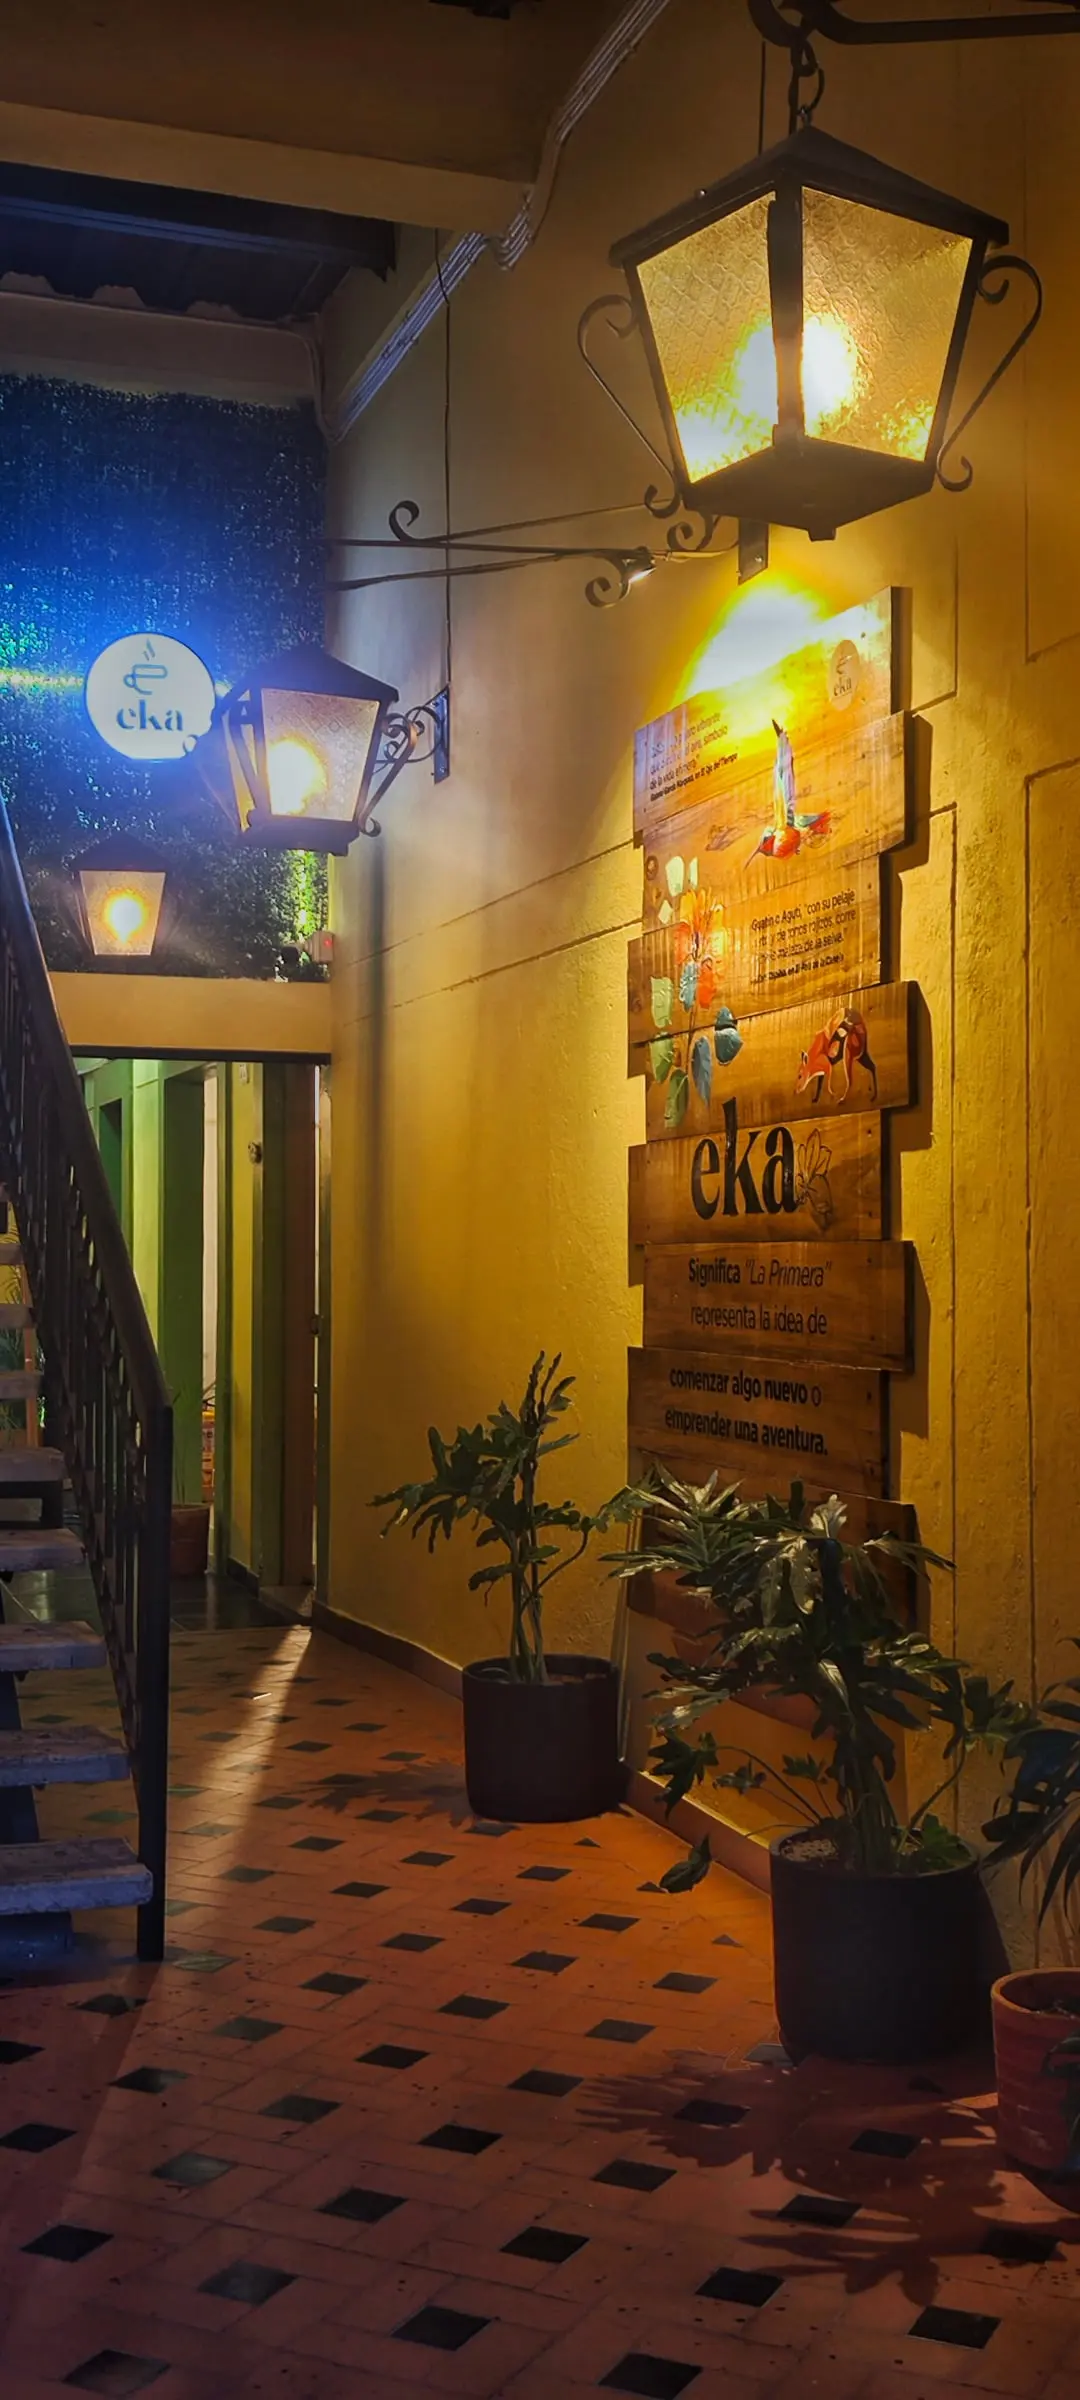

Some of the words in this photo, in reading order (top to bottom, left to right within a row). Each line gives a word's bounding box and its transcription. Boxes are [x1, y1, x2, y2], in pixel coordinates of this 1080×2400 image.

[116, 699, 183, 732] eka
[822, 898, 831, 910] su
[832, 888, 855, 910] pelaje
[691, 1096, 799, 1221] eka
[688, 1257, 741, 1288] Significa
[691, 1305, 756, 1330] representa
[759, 1302, 771, 1331] la
[774, 1304, 804, 1334] idea
[807, 1306, 828, 1335] de
[669, 1368, 730, 1393] comenzar
[732, 1370, 762, 1402] algo
[764, 1378, 808, 1404] nuevo
[811, 1386, 822, 1407] o
[665, 1407, 732, 1437] emprender
[734, 1420, 758, 1443] una
[761, 1423, 828, 1456] aventura.
